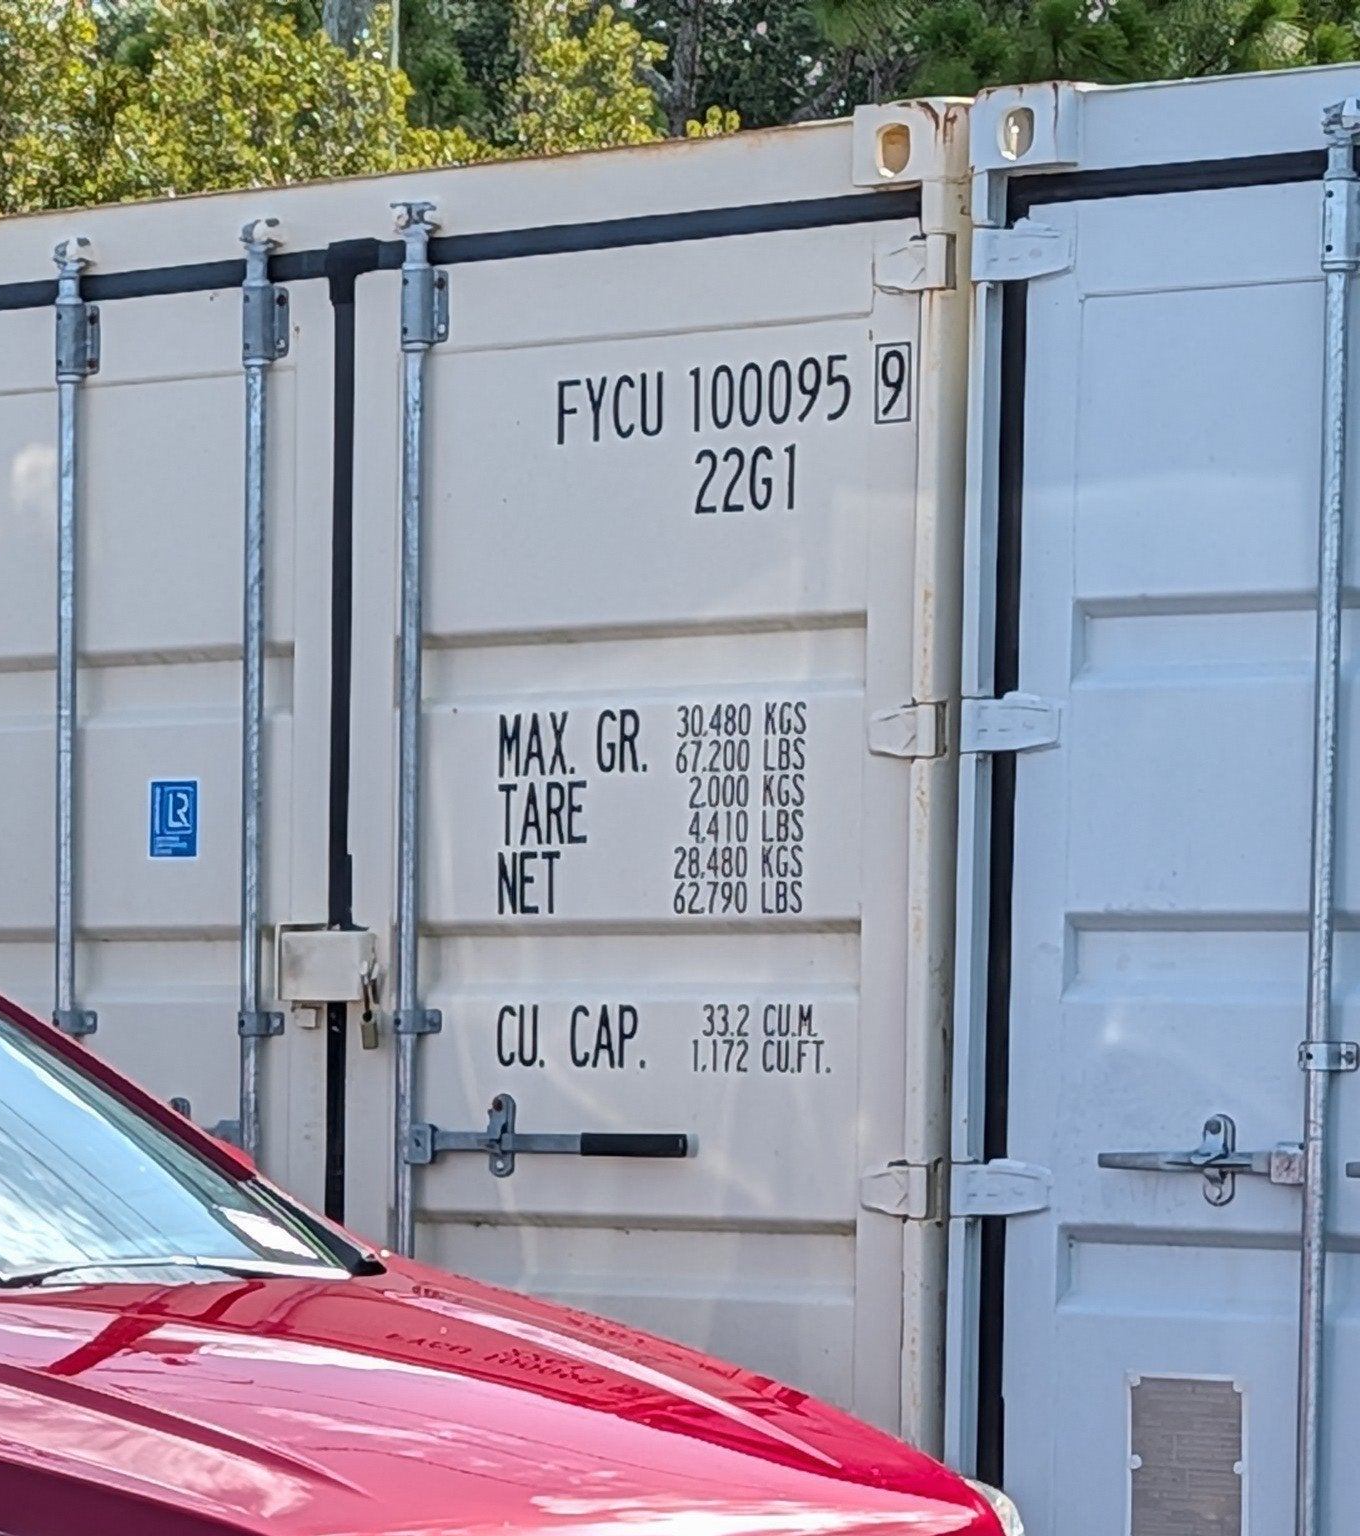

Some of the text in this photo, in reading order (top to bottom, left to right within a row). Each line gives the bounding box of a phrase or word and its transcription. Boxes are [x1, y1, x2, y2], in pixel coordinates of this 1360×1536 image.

[557, 348, 906, 446] FYCU 100095 9
[694, 443, 797, 515] 22G1
[764, 701, 808, 736] KGS
[498, 708, 649, 778] MAX. GR.
[763, 737, 807, 772] LBS
[762, 773, 806, 808] KGS
[497, 780, 588, 846] TARE
[761, 808, 805, 844] LBS
[761, 844, 805, 879] KGS
[497, 850, 562, 915] NET
[761, 880, 804, 915] LBS
[496, 1004, 647, 1069] CU. CAP.
[702, 1003, 751, 1037] 33.2
